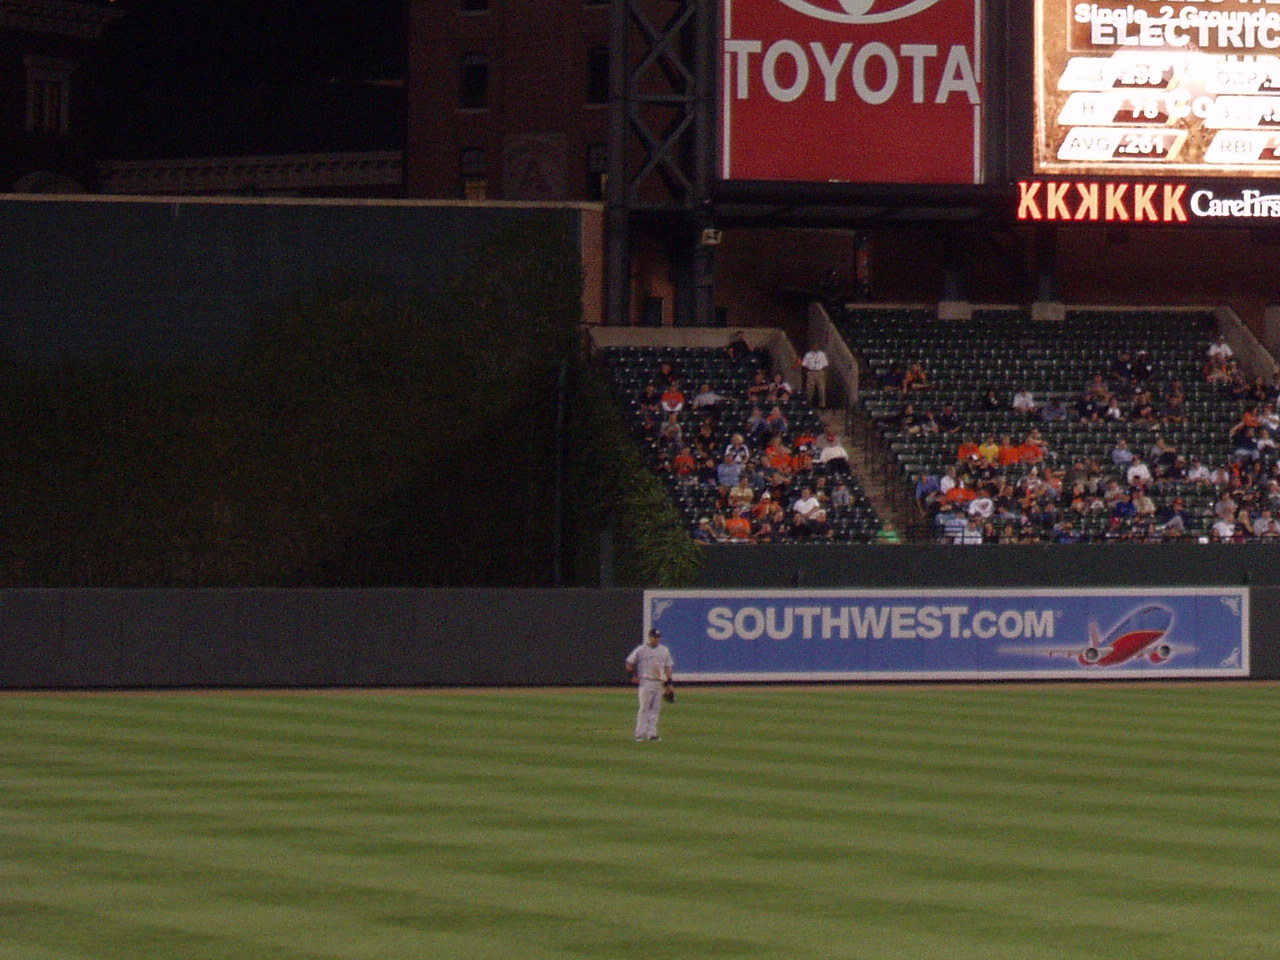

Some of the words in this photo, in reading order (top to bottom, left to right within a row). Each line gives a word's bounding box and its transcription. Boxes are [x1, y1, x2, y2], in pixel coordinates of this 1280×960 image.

[724, 39, 980, 105] TOYOTA
[1069, 137, 1110, 151] AVG
[1220, 140, 1254, 153] RBI
[706, 606, 1056, 640] SOUTHWEST.COM
